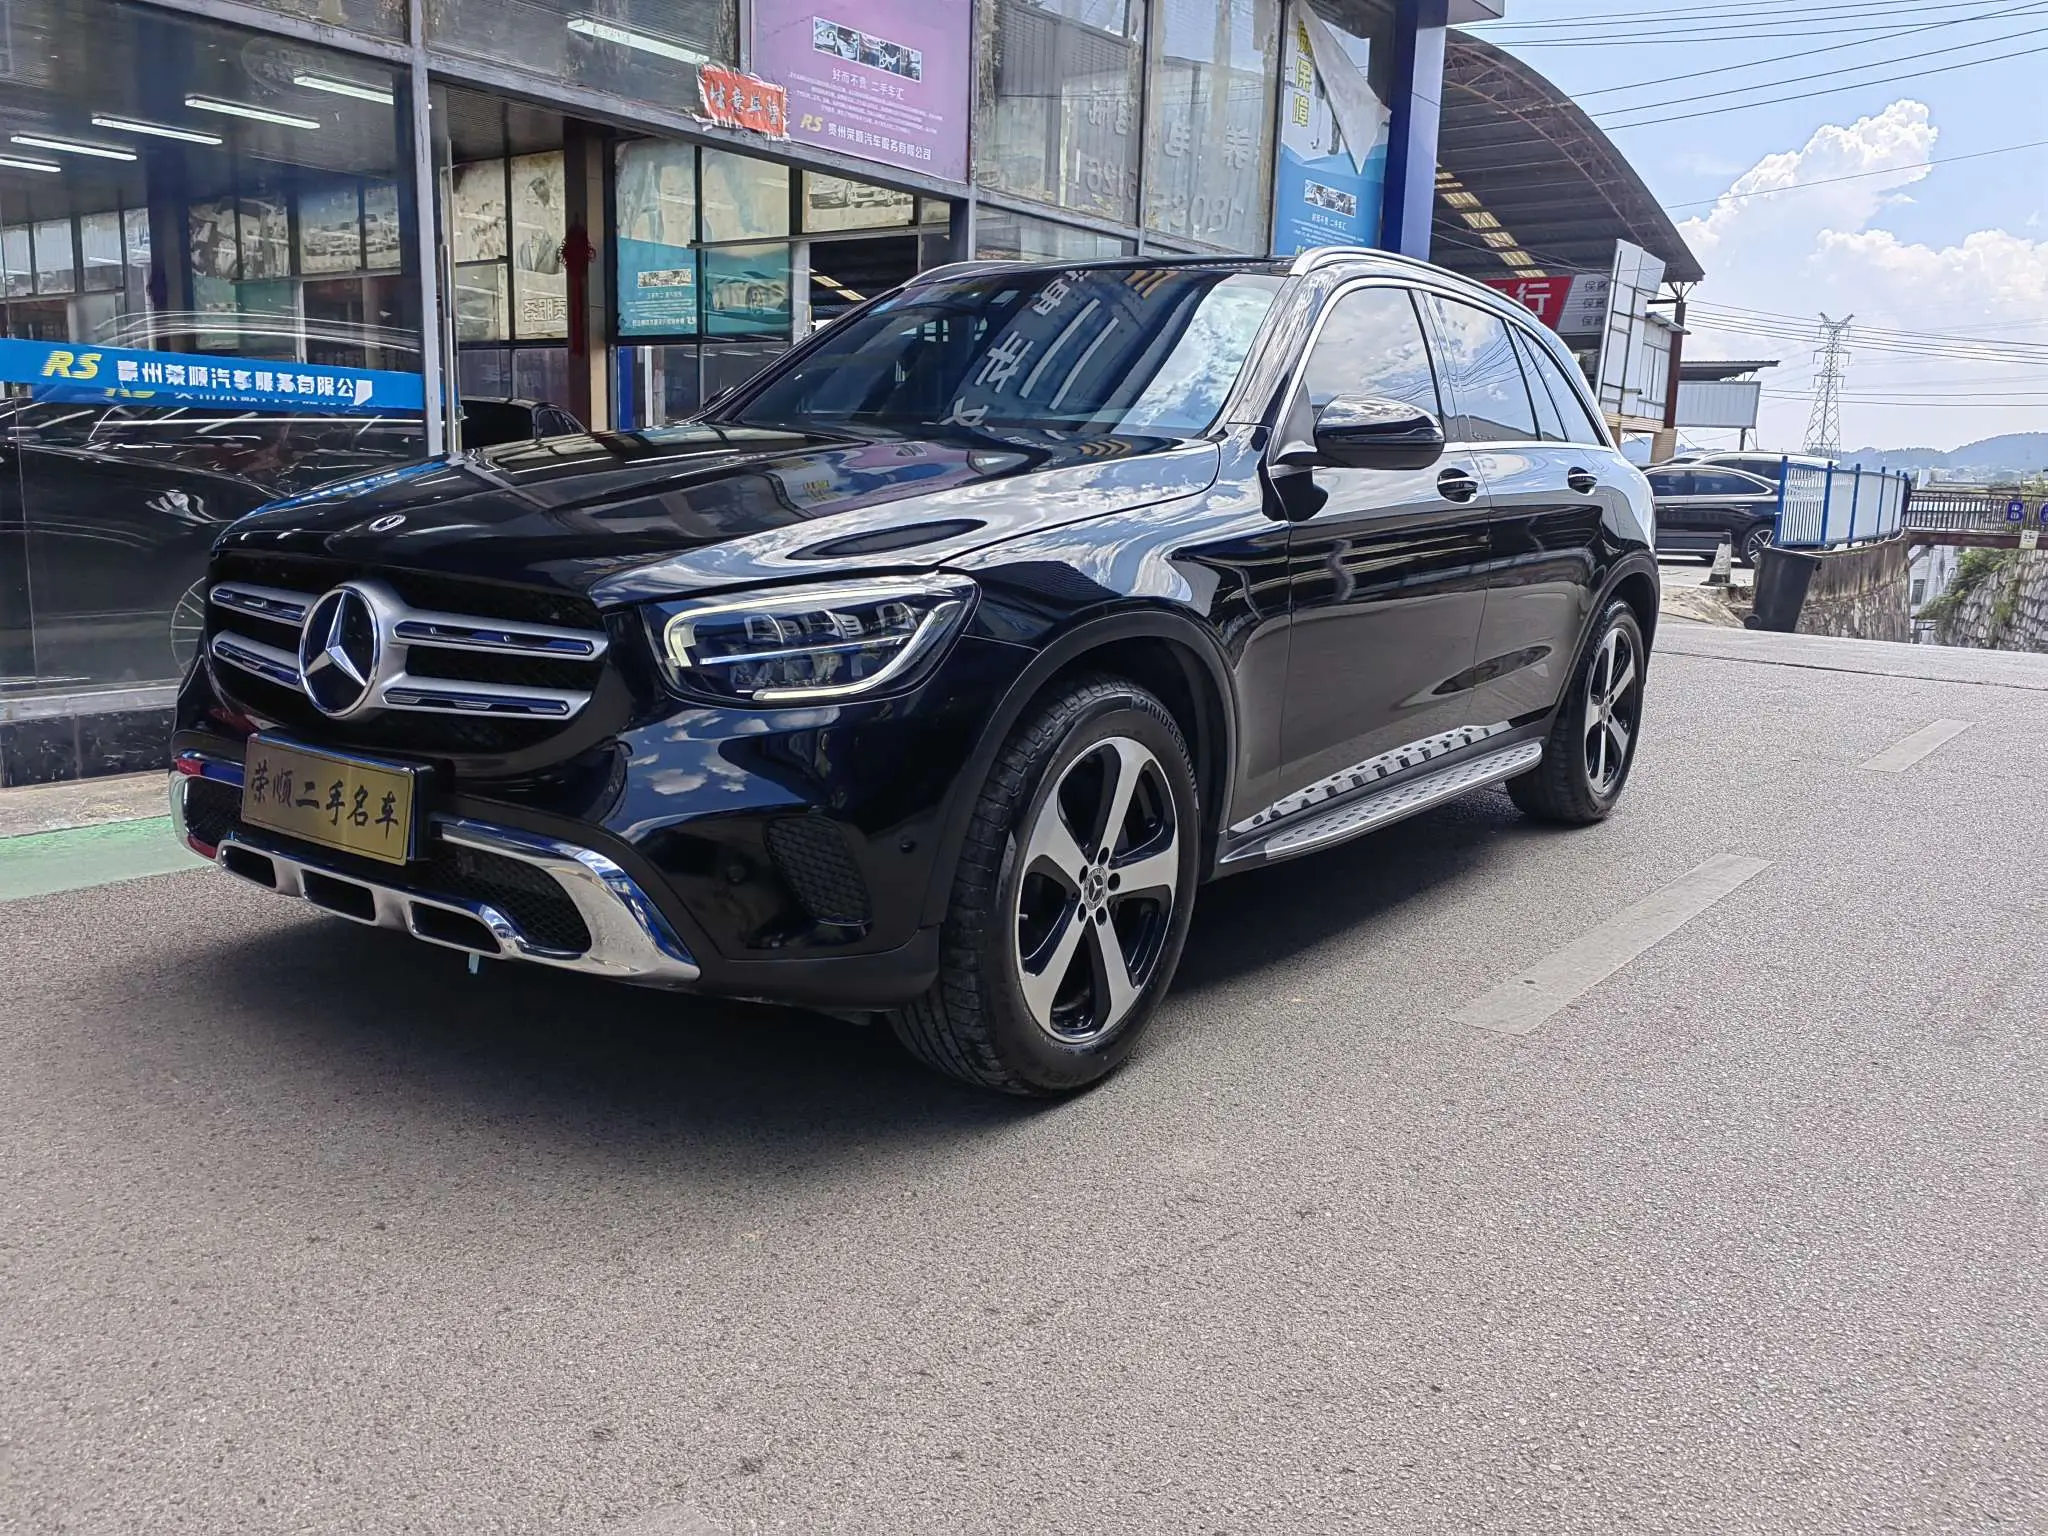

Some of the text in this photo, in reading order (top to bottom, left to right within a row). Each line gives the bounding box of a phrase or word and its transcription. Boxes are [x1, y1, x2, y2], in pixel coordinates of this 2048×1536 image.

[800, 113, 823, 132] RS
[1498, 283, 1552, 316] 行
[40, 350, 102, 380] RS
[117, 360, 373, 405] 贵州荣顺汽车服务有限公
[252, 759, 399, 840] 荣顺二手名车
